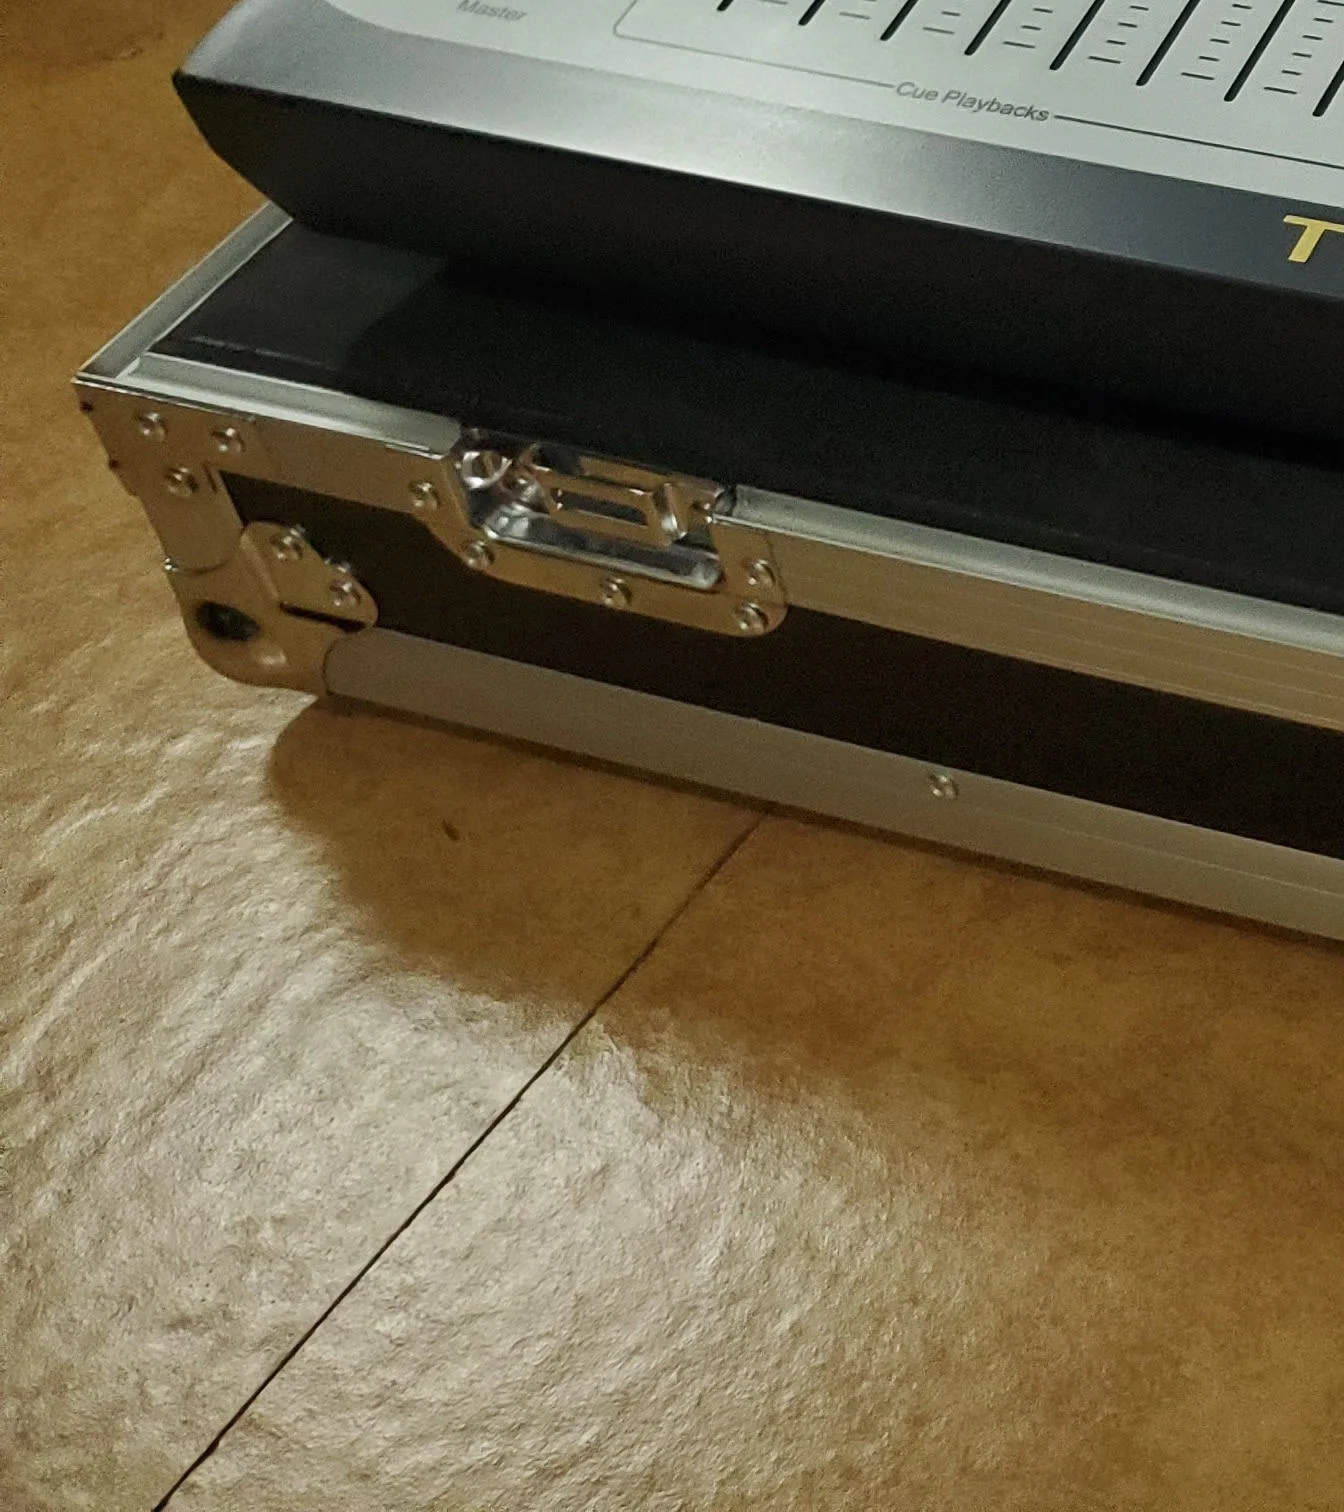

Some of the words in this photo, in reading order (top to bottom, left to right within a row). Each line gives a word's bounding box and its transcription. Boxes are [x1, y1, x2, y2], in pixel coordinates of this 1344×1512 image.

[457, 0, 527, 23] Master
[897, 82, 939, 102] Cue
[941, 91, 1048, 123] Playbacks
